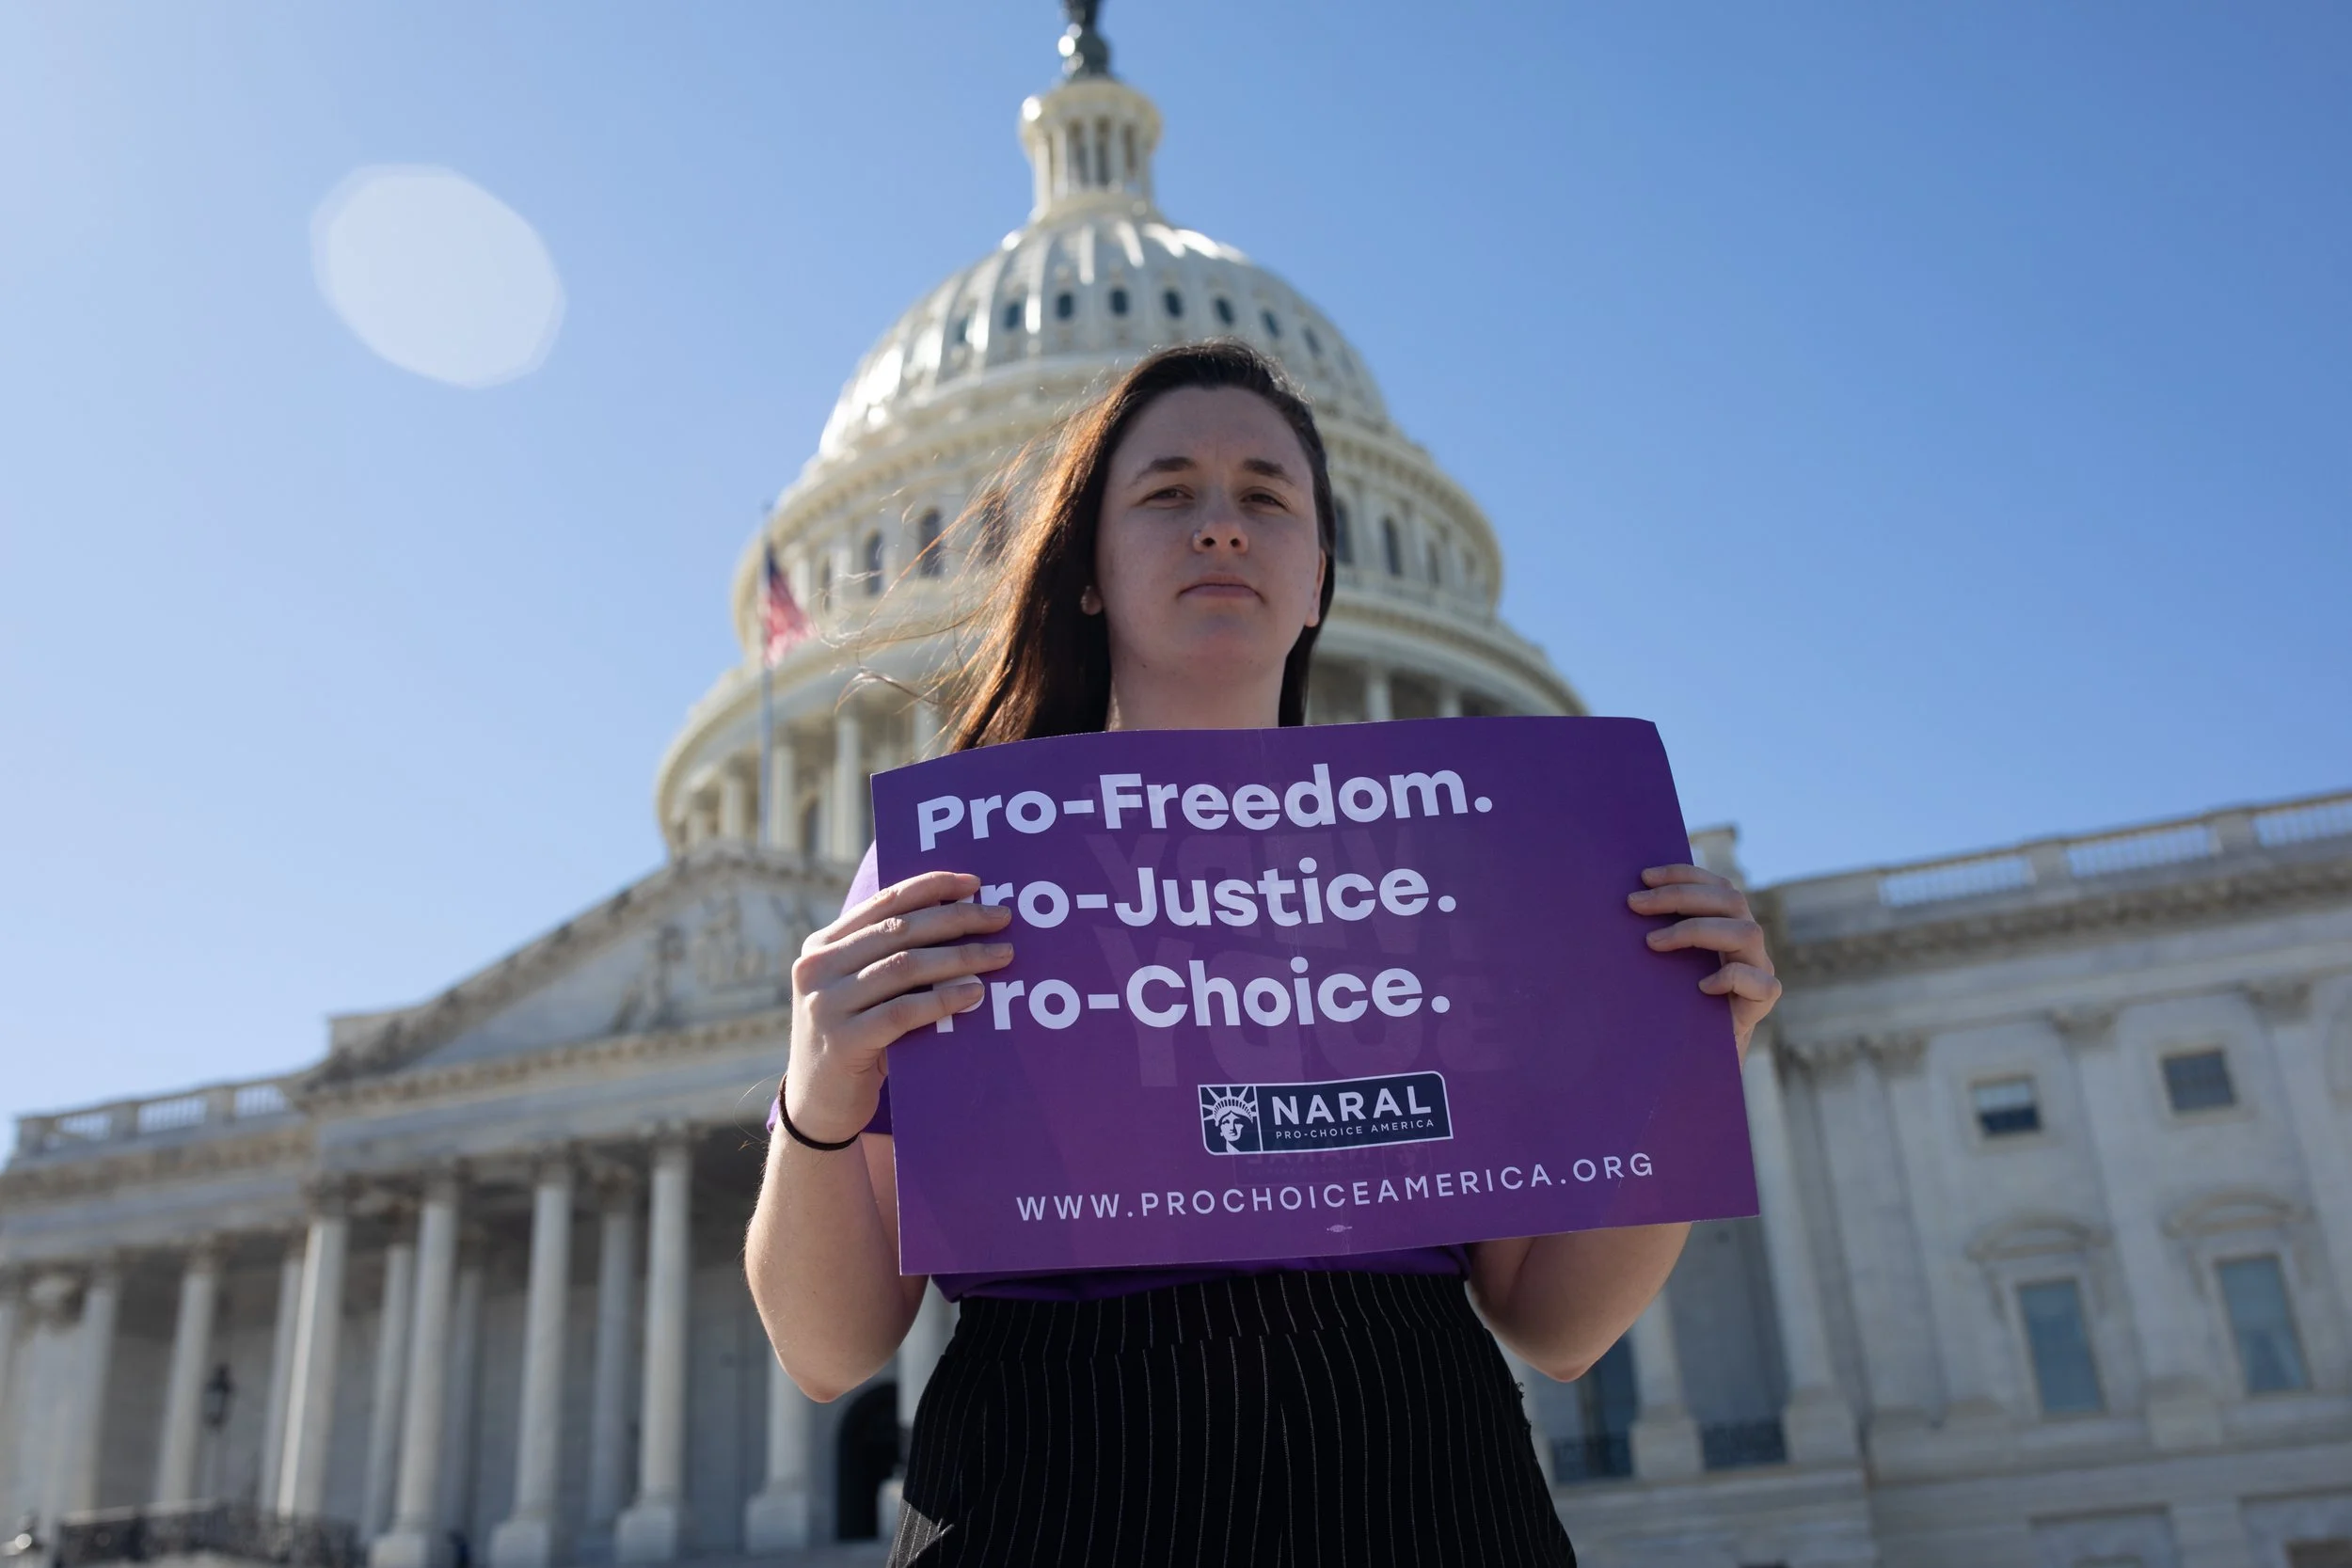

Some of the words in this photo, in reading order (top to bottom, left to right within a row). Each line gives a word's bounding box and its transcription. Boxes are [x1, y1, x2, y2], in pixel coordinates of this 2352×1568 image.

[917, 764, 1493, 852] Pro-Freedom.
[956, 858, 1456, 928] ro-Justice.
[1271, 1085, 1432, 1126] NARAL
[1276, 1126, 1363, 1139] PRO-CHOICE
[1371, 1118, 1435, 1132] AMERICA
[1016, 1152, 1653, 1222] WWW.PROCHOICEAMERICA.ORG
